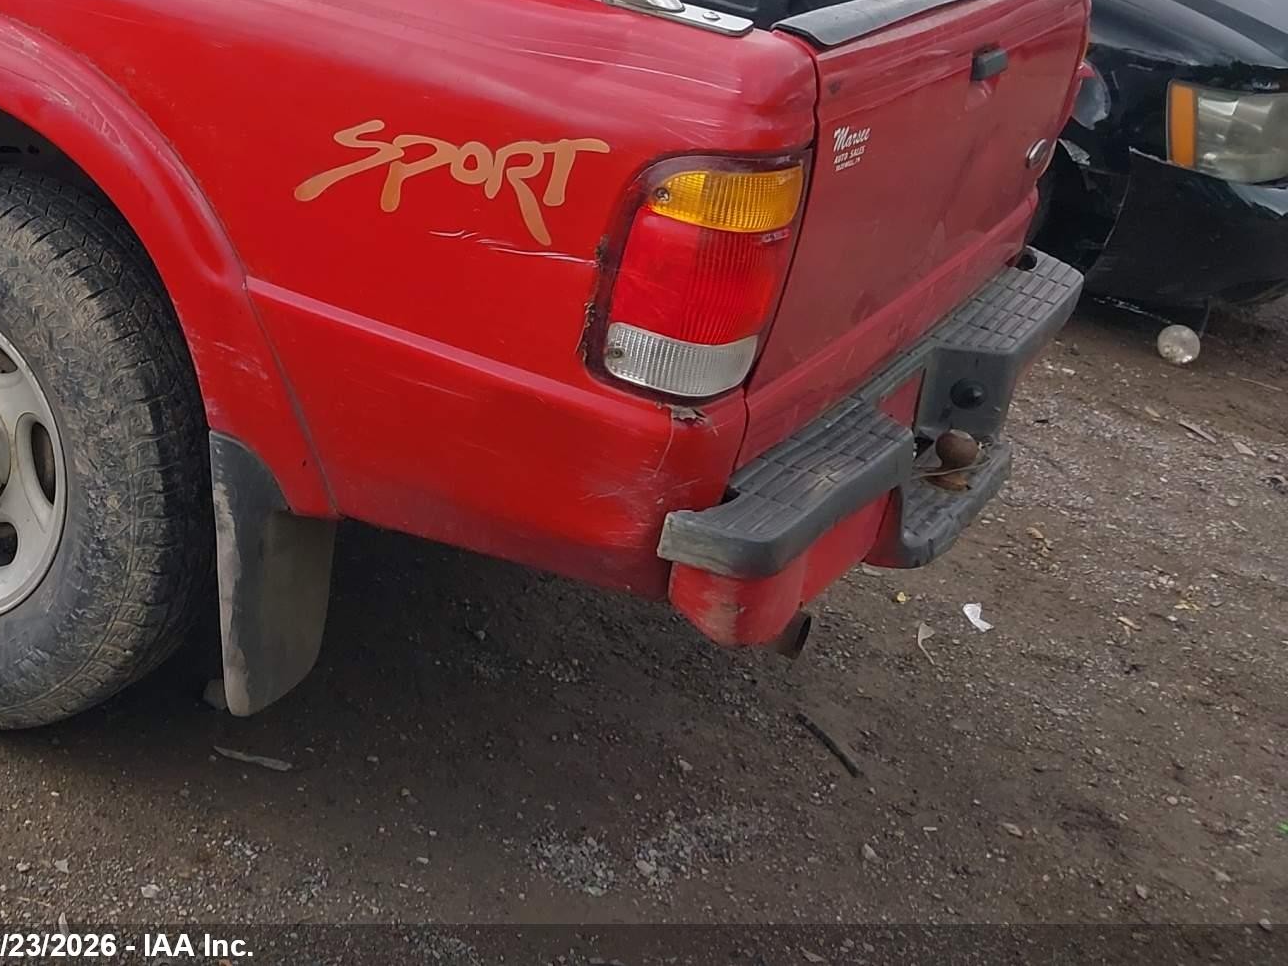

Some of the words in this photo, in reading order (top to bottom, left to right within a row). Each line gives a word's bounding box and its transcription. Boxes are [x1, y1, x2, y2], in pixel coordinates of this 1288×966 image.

[294, 120, 610, 246] SPORT
[833, 152, 849, 164] AUTO
[849, 145, 866, 158] SALES
